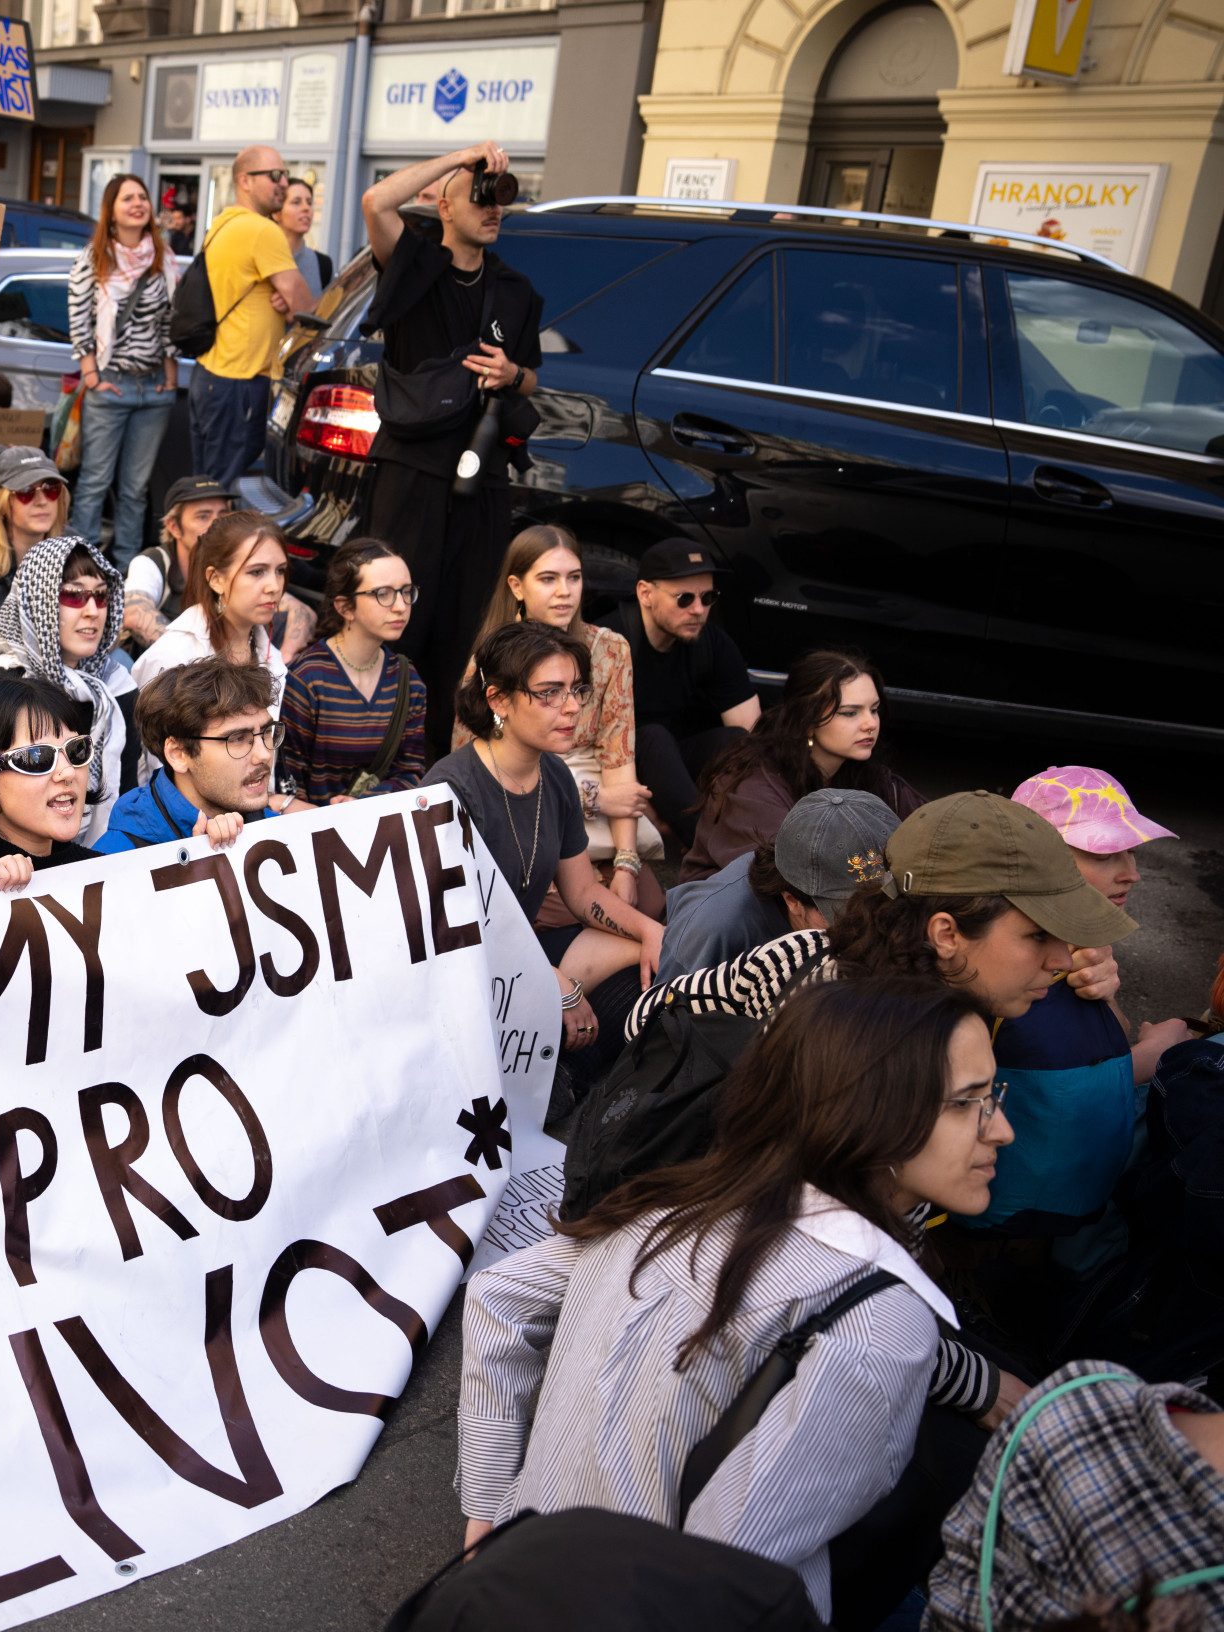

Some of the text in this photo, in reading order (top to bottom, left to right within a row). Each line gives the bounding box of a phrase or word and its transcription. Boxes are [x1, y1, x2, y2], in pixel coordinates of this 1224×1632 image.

[386, 79, 534, 105] GIFT SHOP
[988, 181, 1138, 206] HRANOLKY
